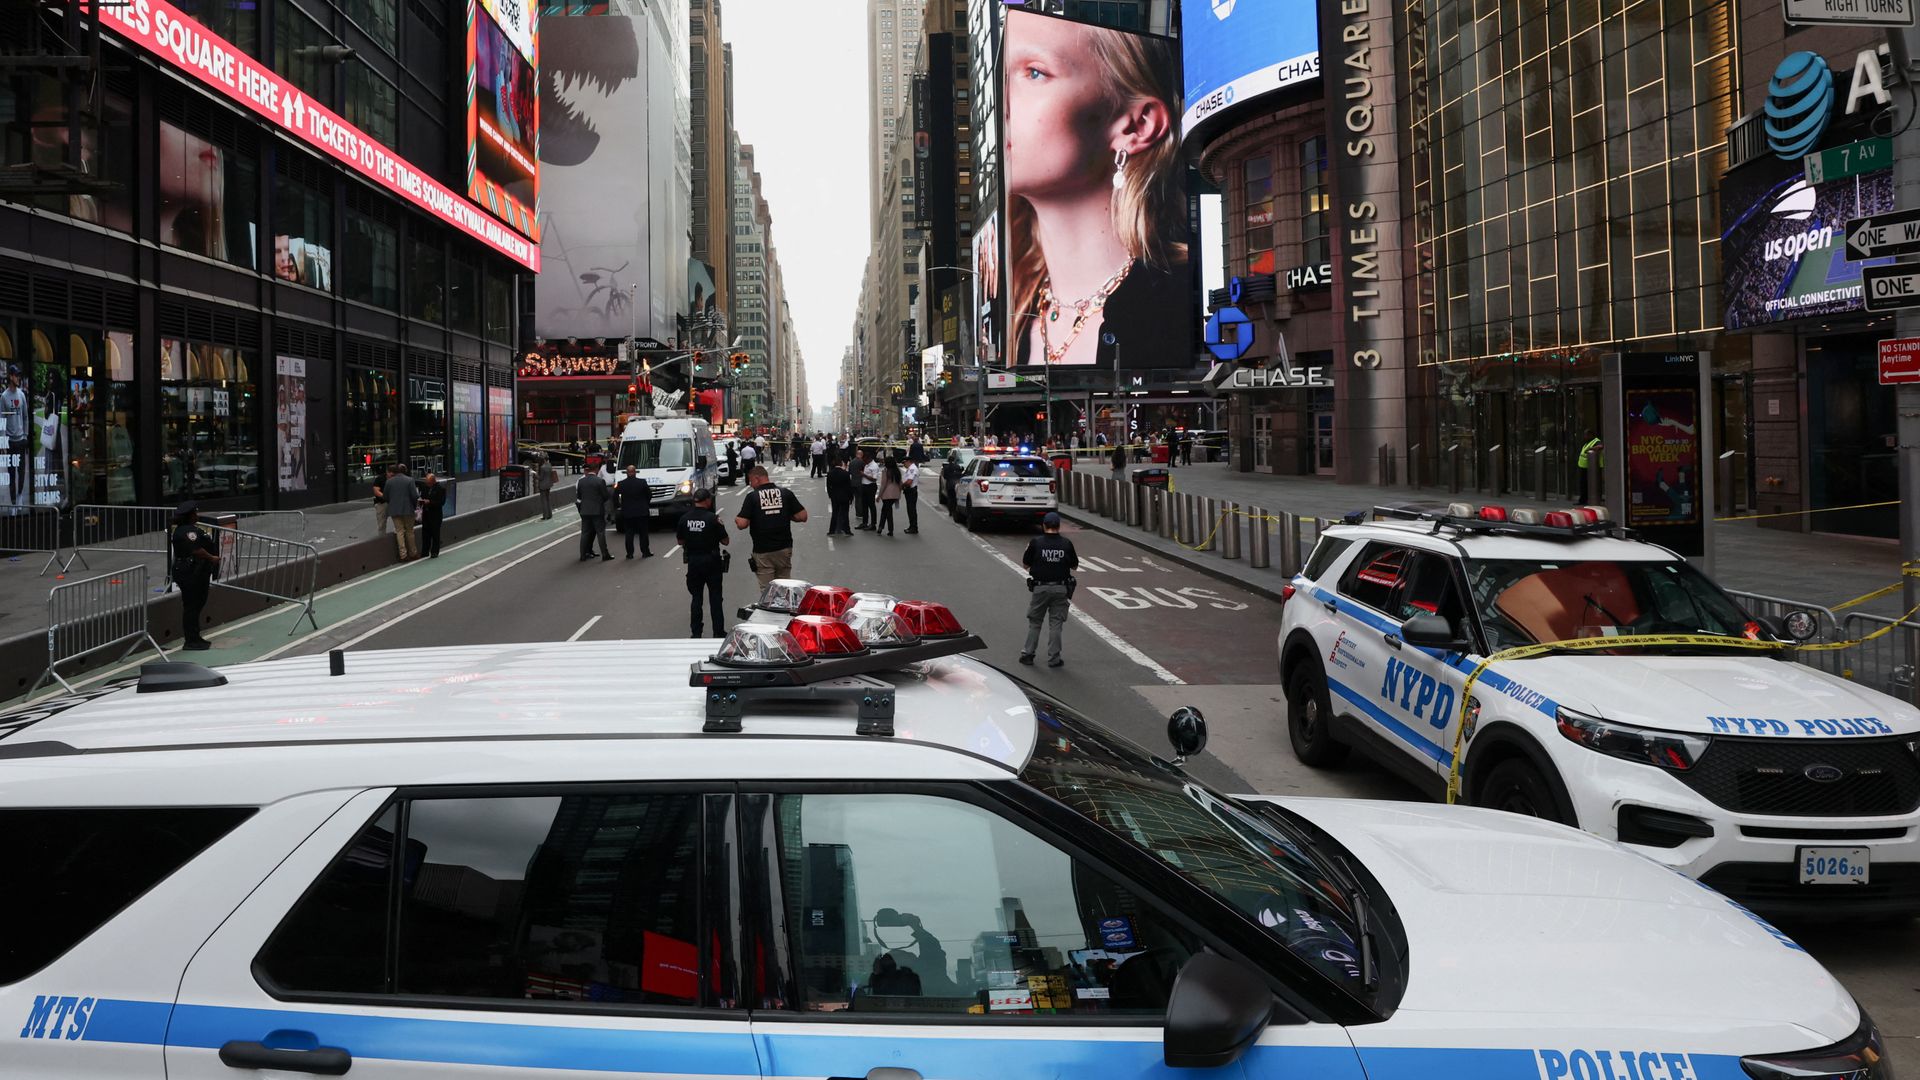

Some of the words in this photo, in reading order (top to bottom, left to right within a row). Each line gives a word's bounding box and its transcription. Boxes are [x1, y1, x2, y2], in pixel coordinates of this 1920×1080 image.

[1825, 0, 1858, 12] RIGHT
[1865, 0, 1903, 13] TURNS
[1278, 56, 1320, 81] CHAS
[1342, 0, 1377, 157] SQUARE
[1196, 92, 1223, 119] CHASE
[155, 10, 235, 87] SQUARE
[238, 61, 279, 114] HERE
[308, 106, 357, 160] TICKETS
[359, 138, 374, 170] TO
[375, 149, 394, 183] THE
[395, 162, 422, 198] TIMES
[423, 181, 453, 218] SQUARE
[453, 201, 486, 237] SKYWALK
[1841, 150, 1850, 172] 7
[1764, 240, 1782, 262] us
[1784, 226, 1832, 262] open
[1858, 228, 1887, 247] ONE
[1350, 201, 1380, 322] TIMES
[1286, 264, 1332, 289] CHAS
[1876, 277, 1914, 296] ONE
[1765, 296, 1797, 312] OFFICIAL
[1800, 286, 1861, 306] CONNECTIVIT
[1881, 345, 1891, 353] NO
[1893, 342, 1920, 353] STANDI
[525, 352, 618, 373] Subway
[1354, 349, 1380, 368] 3
[1664, 355, 1694, 363] LinkNYC
[1882, 354, 1911, 365] Anytime
[1233, 367, 1323, 387] CHASE
[1632, 444, 1692, 455] BROADWAY
[1641, 435, 1664, 445] NYC
[11, 454, 21, 467] OF
[34, 457, 45, 469] THE
[1650, 452, 1680, 463] WEEK
[49, 474, 58, 486] OF
[759, 489, 781, 499] NYPD
[760, 497, 782, 506] POLICE
[687, 520, 705, 528] NYPD
[1042, 549, 1064, 558] NYPD
[1086, 586, 1249, 611] BUS
[1381, 656, 1454, 730] NYPD
[1503, 680, 1543, 709] POLICE
[1706, 716, 1790, 735] NYPD
[1794, 717, 1894, 736] POLICE
[1806, 857, 1849, 875] 5026
[1850, 866, 1864, 876] 20
[20, 995, 94, 1041] MTS
[1539, 1049, 1692, 1080] POLICE
